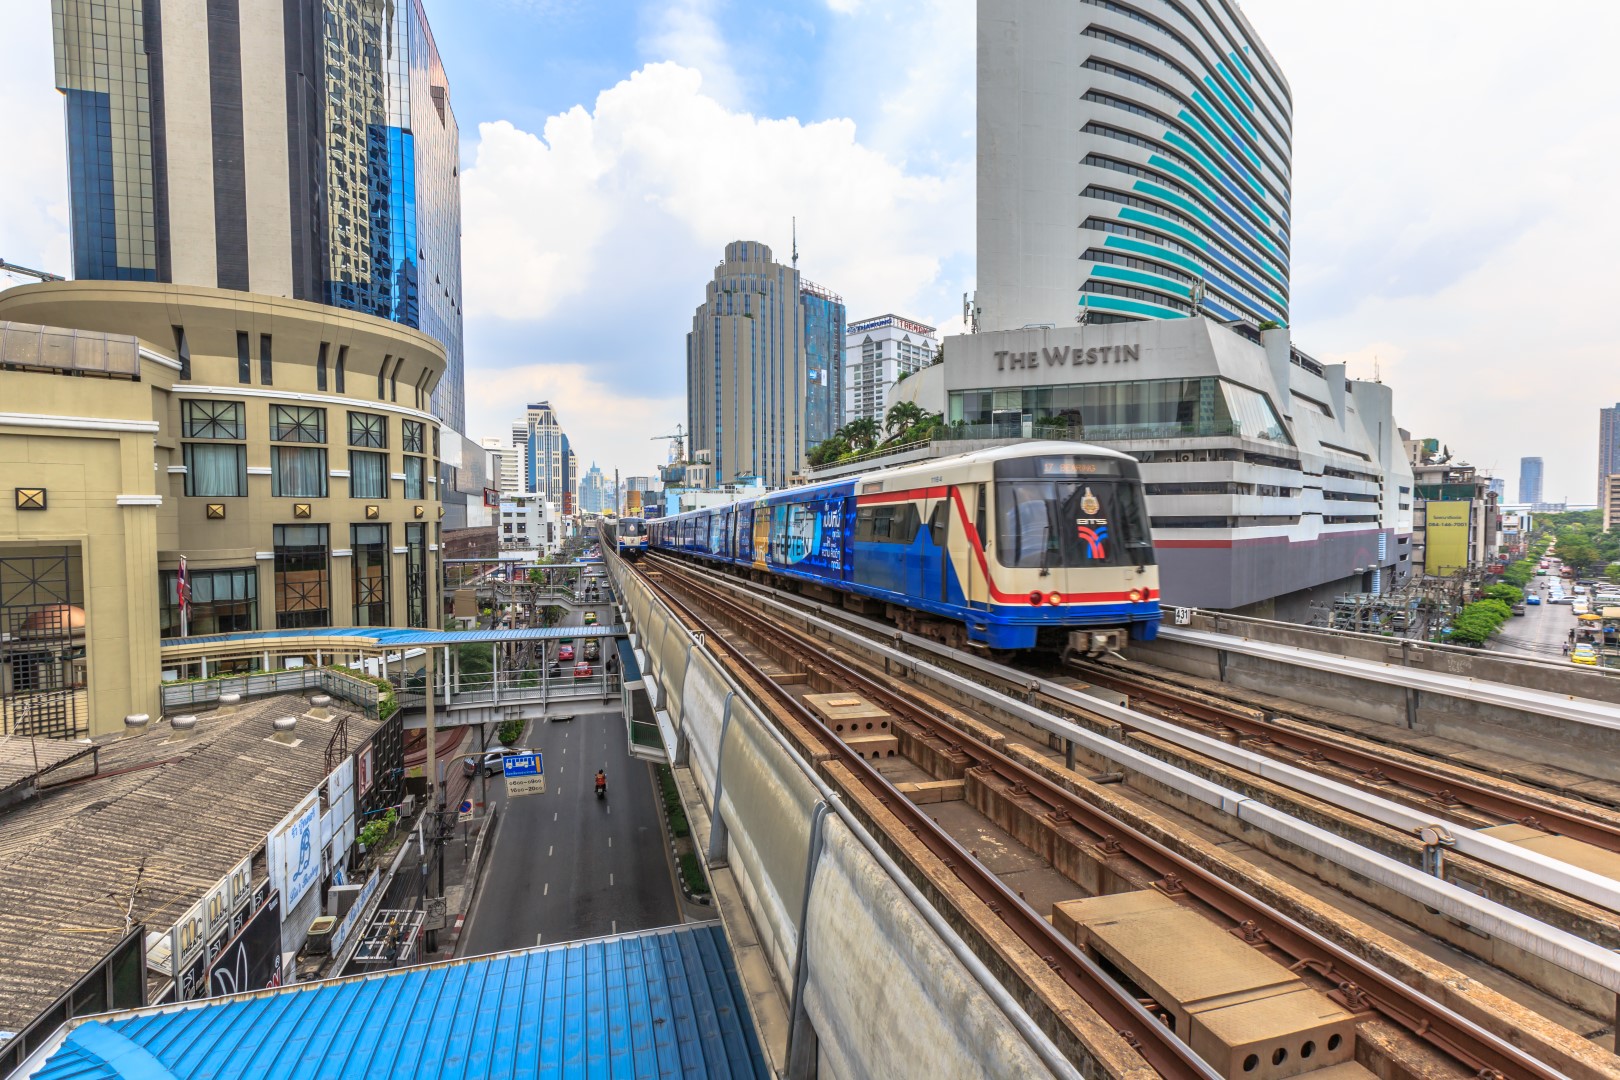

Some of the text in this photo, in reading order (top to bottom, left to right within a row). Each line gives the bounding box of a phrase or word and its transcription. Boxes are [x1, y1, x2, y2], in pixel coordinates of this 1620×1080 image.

[994, 343, 1140, 371] THE WESTIN
[1176, 609, 1188, 619] 431
